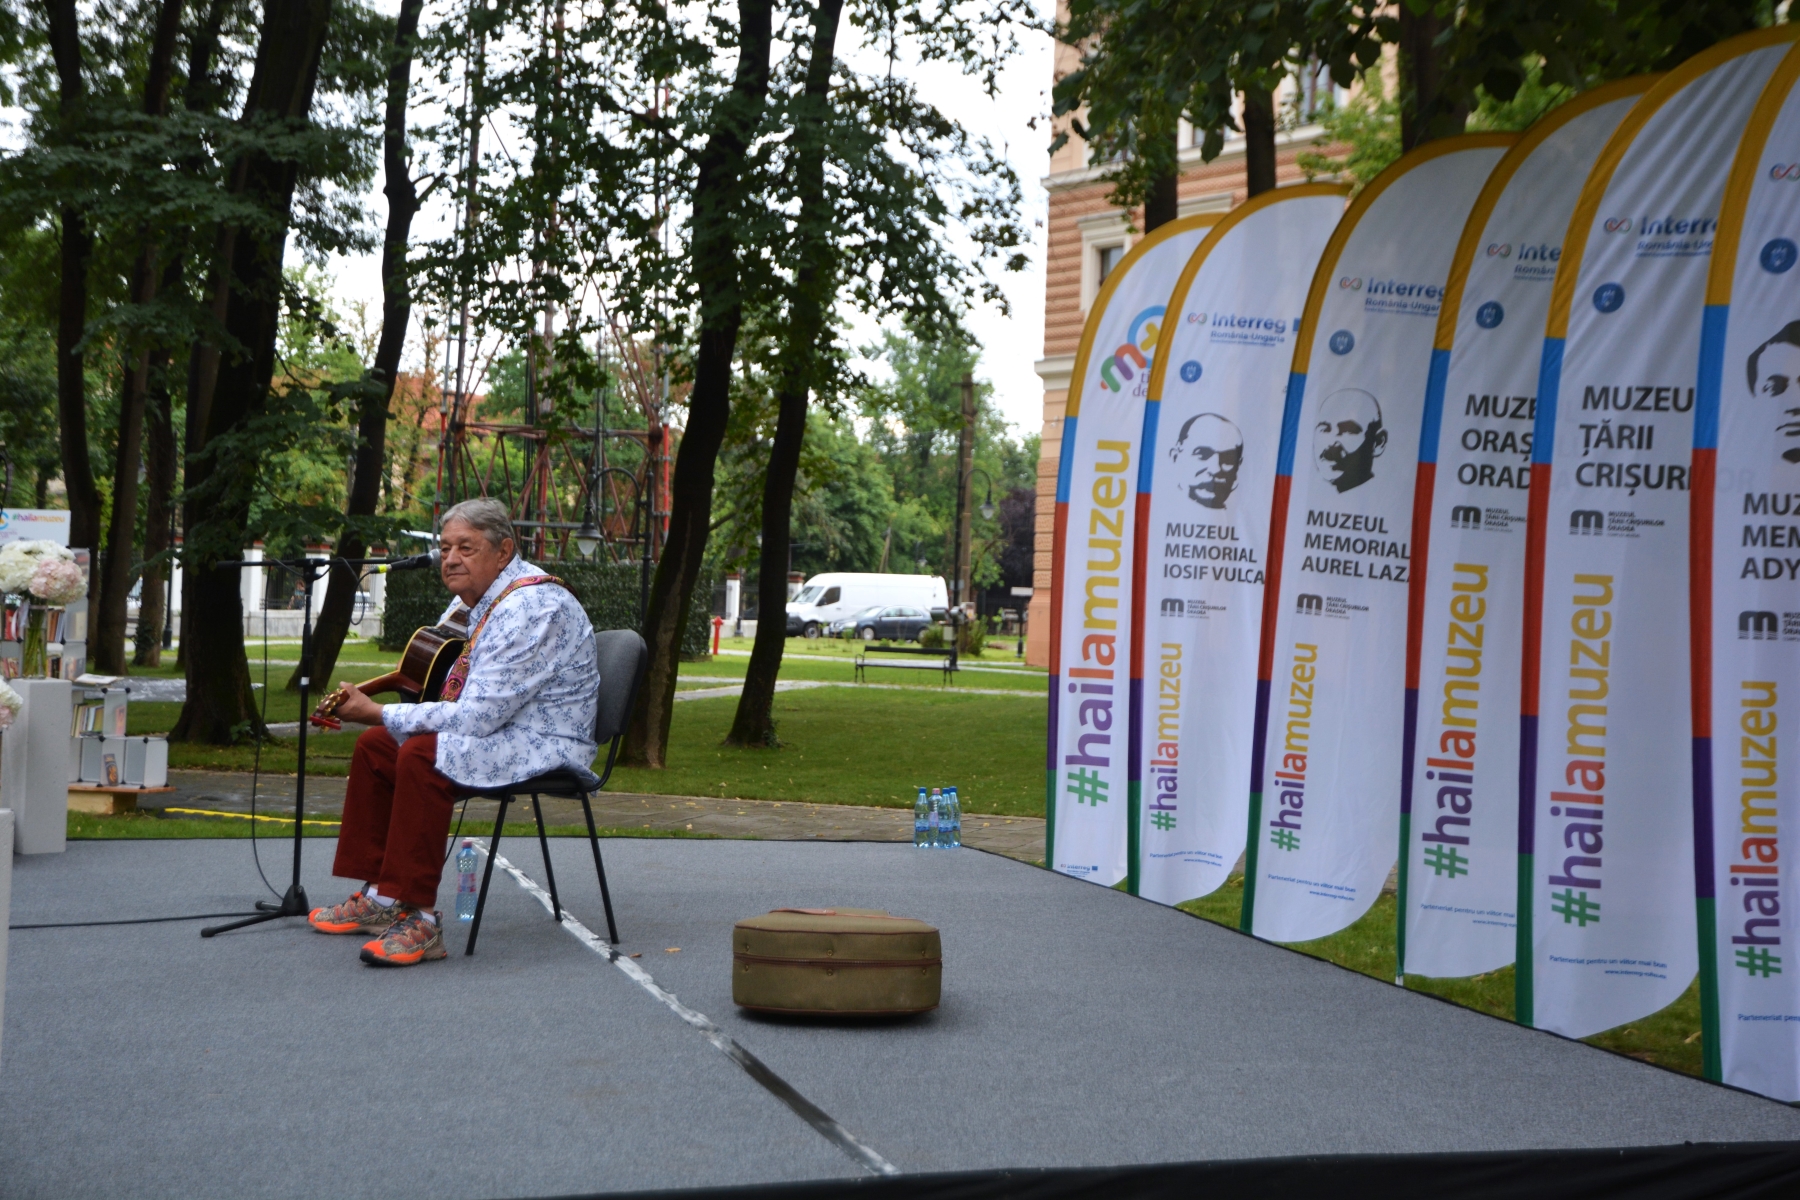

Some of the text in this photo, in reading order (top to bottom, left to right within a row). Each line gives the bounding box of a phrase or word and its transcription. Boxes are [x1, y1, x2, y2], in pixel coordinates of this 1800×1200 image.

[1640, 215, 1717, 235] Interr
[1518, 242, 1561, 261] Inte
[1212, 312, 1287, 334] Interreg
[1464, 394, 1538, 420] MUZE
[1582, 386, 1695, 413] MUZEU
[1461, 428, 1534, 462] ORAȘ
[1579, 419, 1654, 456] ȚĂRII
[1457, 462, 1531, 490] ORAD
[1743, 492, 1800, 516] MUZ
[1165, 522, 1240, 541] MUZEUL
[1305, 510, 1389, 535] MUZEUL
[1164, 543, 1258, 564] MEMORIAL
[1303, 532, 1411, 560] MEMORIAL
[1163, 563, 1266, 586] IOSIF VULCA
[1301, 555, 1411, 584] AUREL LAZ
[1740, 557, 1800, 580] ADY
[1065, 440, 1131, 807] #hailamuzeu
[1422, 562, 1489, 879] #hailamuzeu
[1149, 642, 1183, 831] #hailamuzeu
[1270, 643, 1318, 852] #hailamuzeu
[1548, 573, 1614, 928] #hailamuzeu
[1730, 680, 1783, 979] #hailamuzeu
